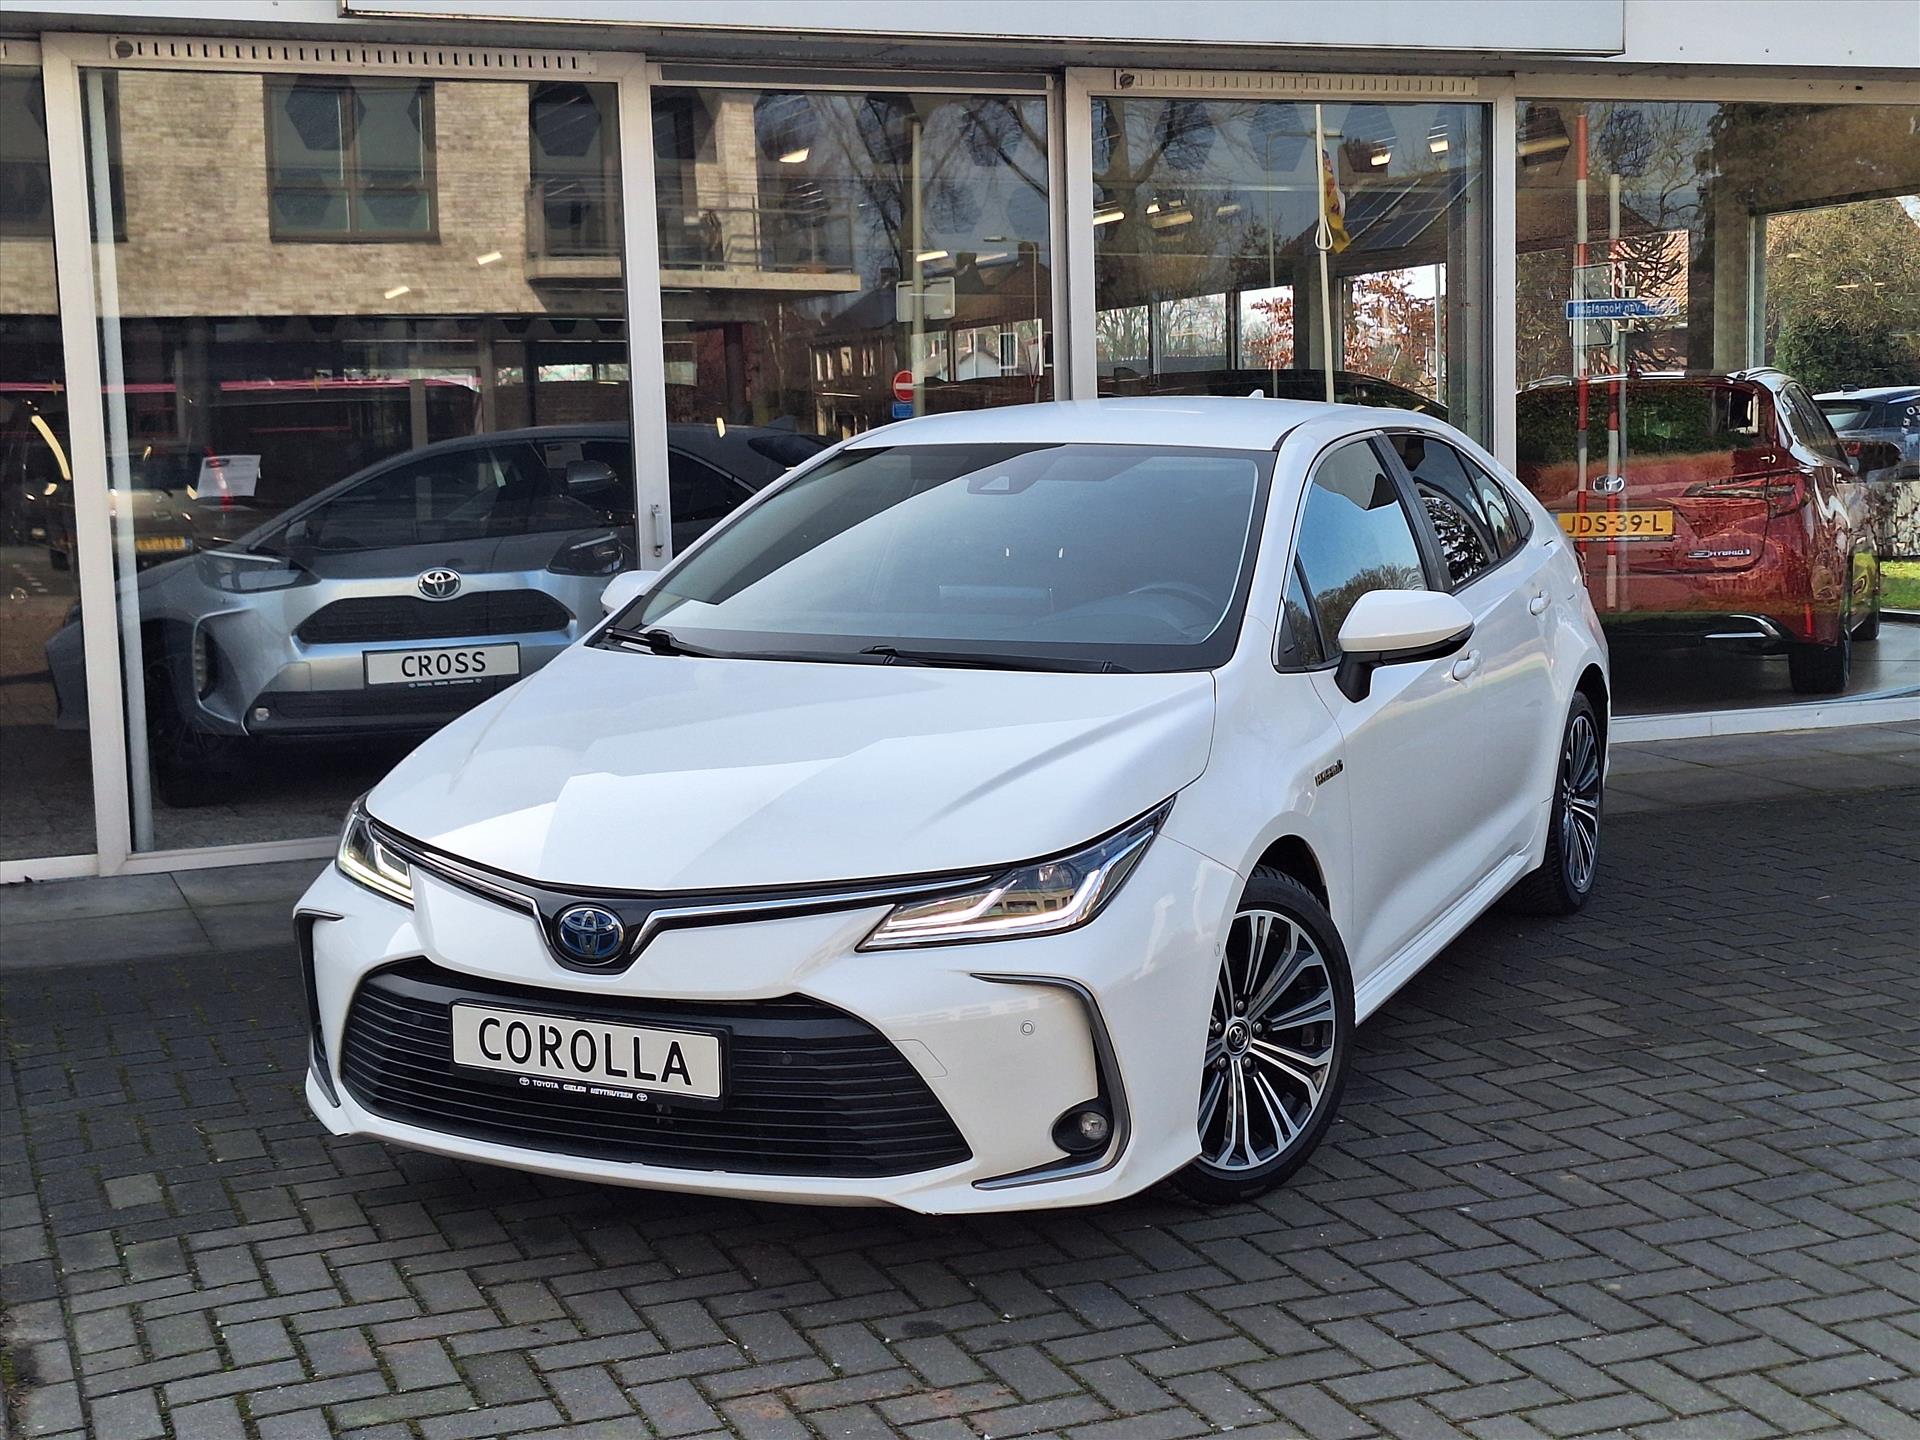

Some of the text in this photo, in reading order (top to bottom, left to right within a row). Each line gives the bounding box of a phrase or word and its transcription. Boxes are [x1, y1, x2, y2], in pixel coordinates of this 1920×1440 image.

[1566, 514, 1663, 534] JDS-39-L
[401, 651, 486, 678] CROSS
[478, 1017, 692, 1086] COROLLA
[532, 1079, 559, 1090] TOYOTA
